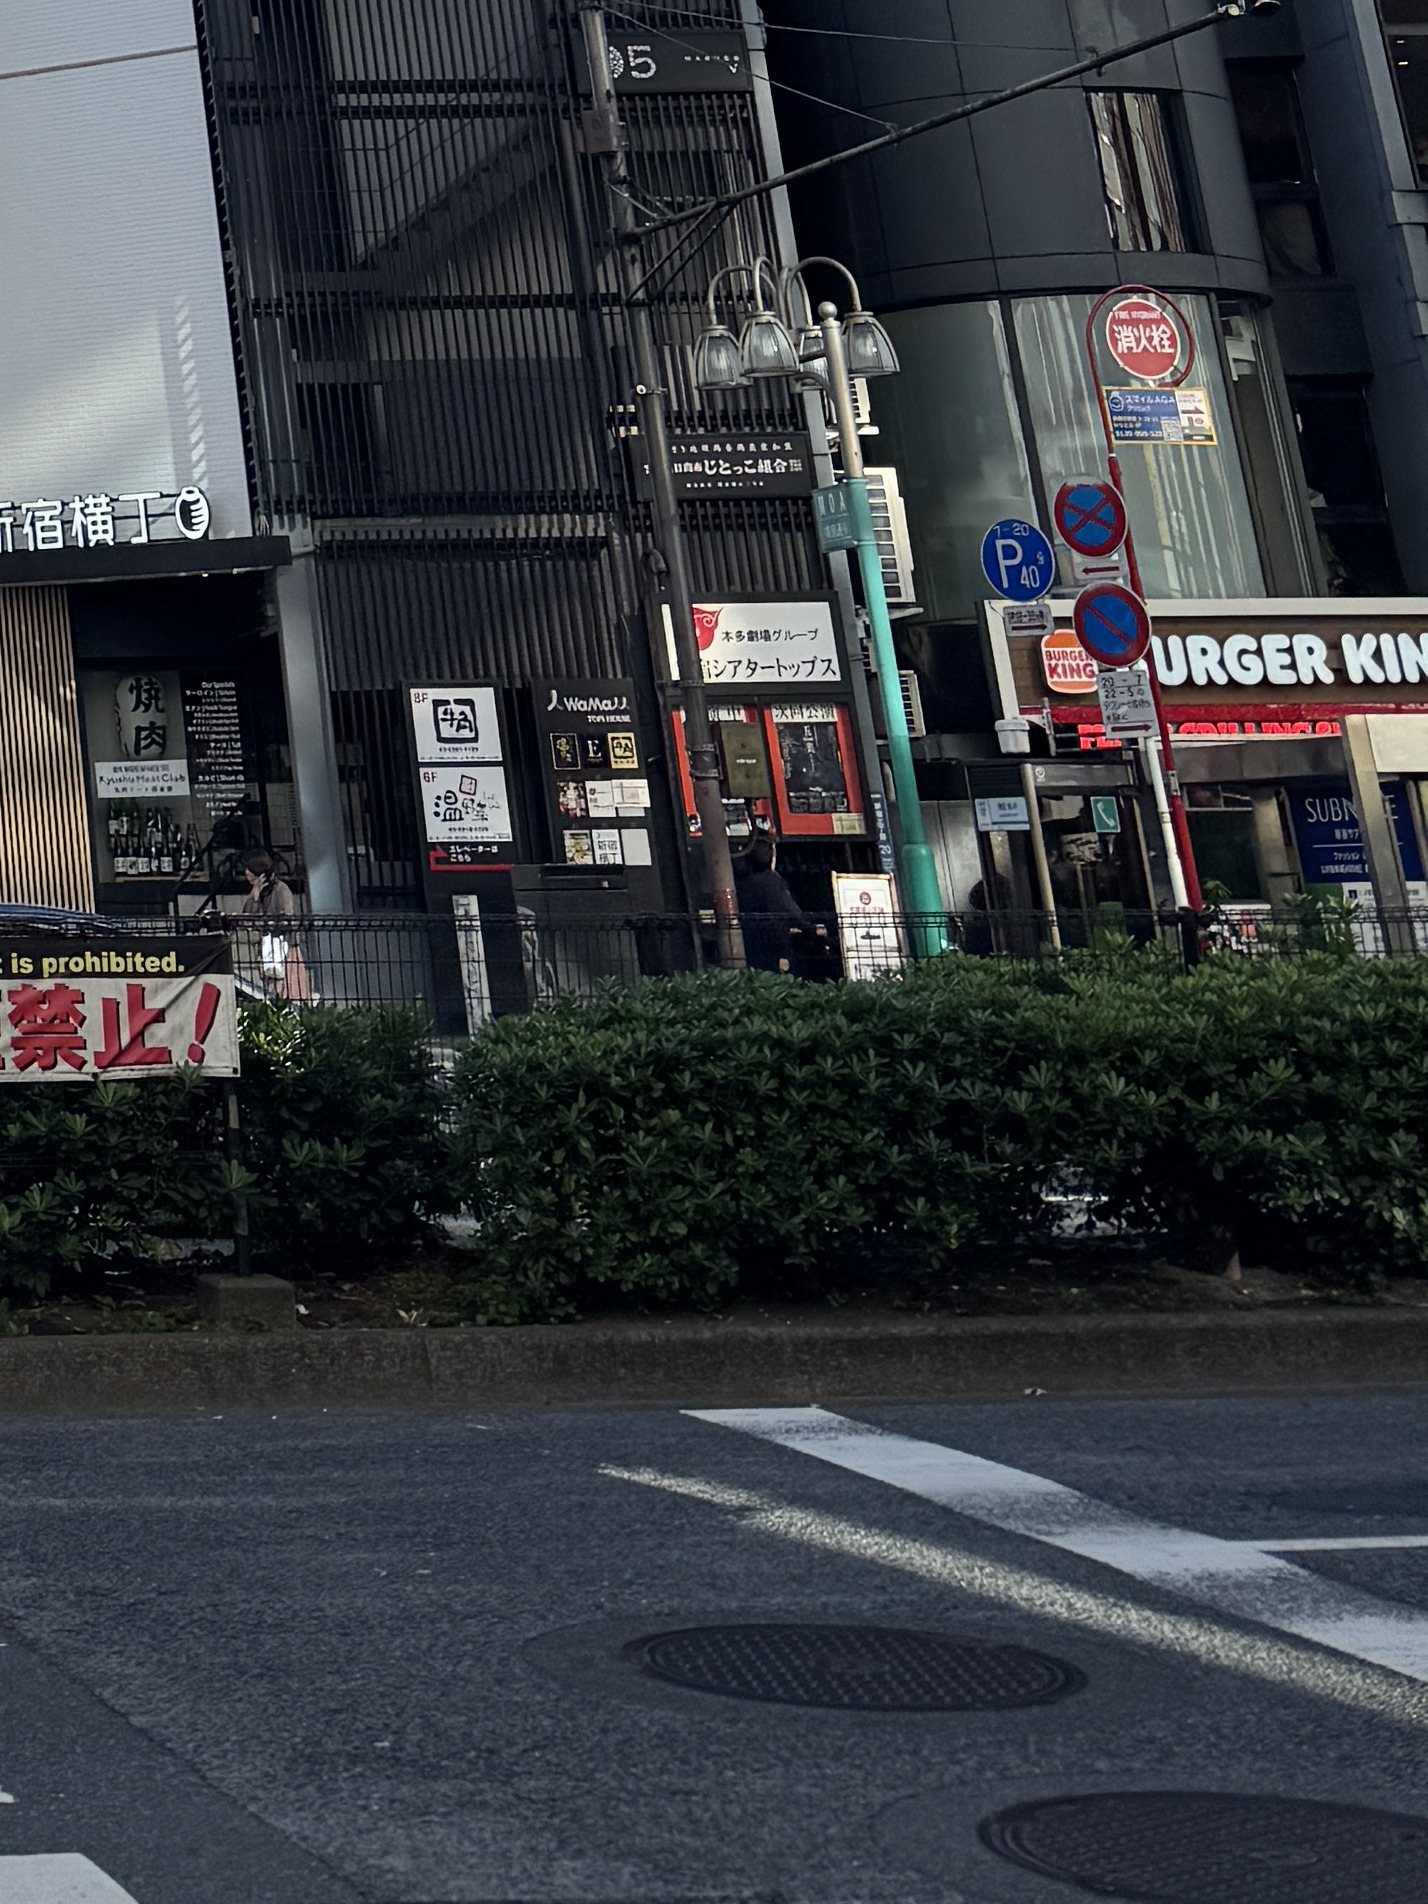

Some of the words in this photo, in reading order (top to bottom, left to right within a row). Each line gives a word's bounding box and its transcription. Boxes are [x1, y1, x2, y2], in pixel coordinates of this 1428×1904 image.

[1113, 323, 1175, 354] 消火栓
[995, 539, 1023, 589] P
[1048, 663, 1094, 678] KING
[1151, 634, 1335, 686] URGER
[128, 677, 167, 757] 焼肉
[10, 953, 34, 974] is
[41, 950, 186, 980] prohibited.
